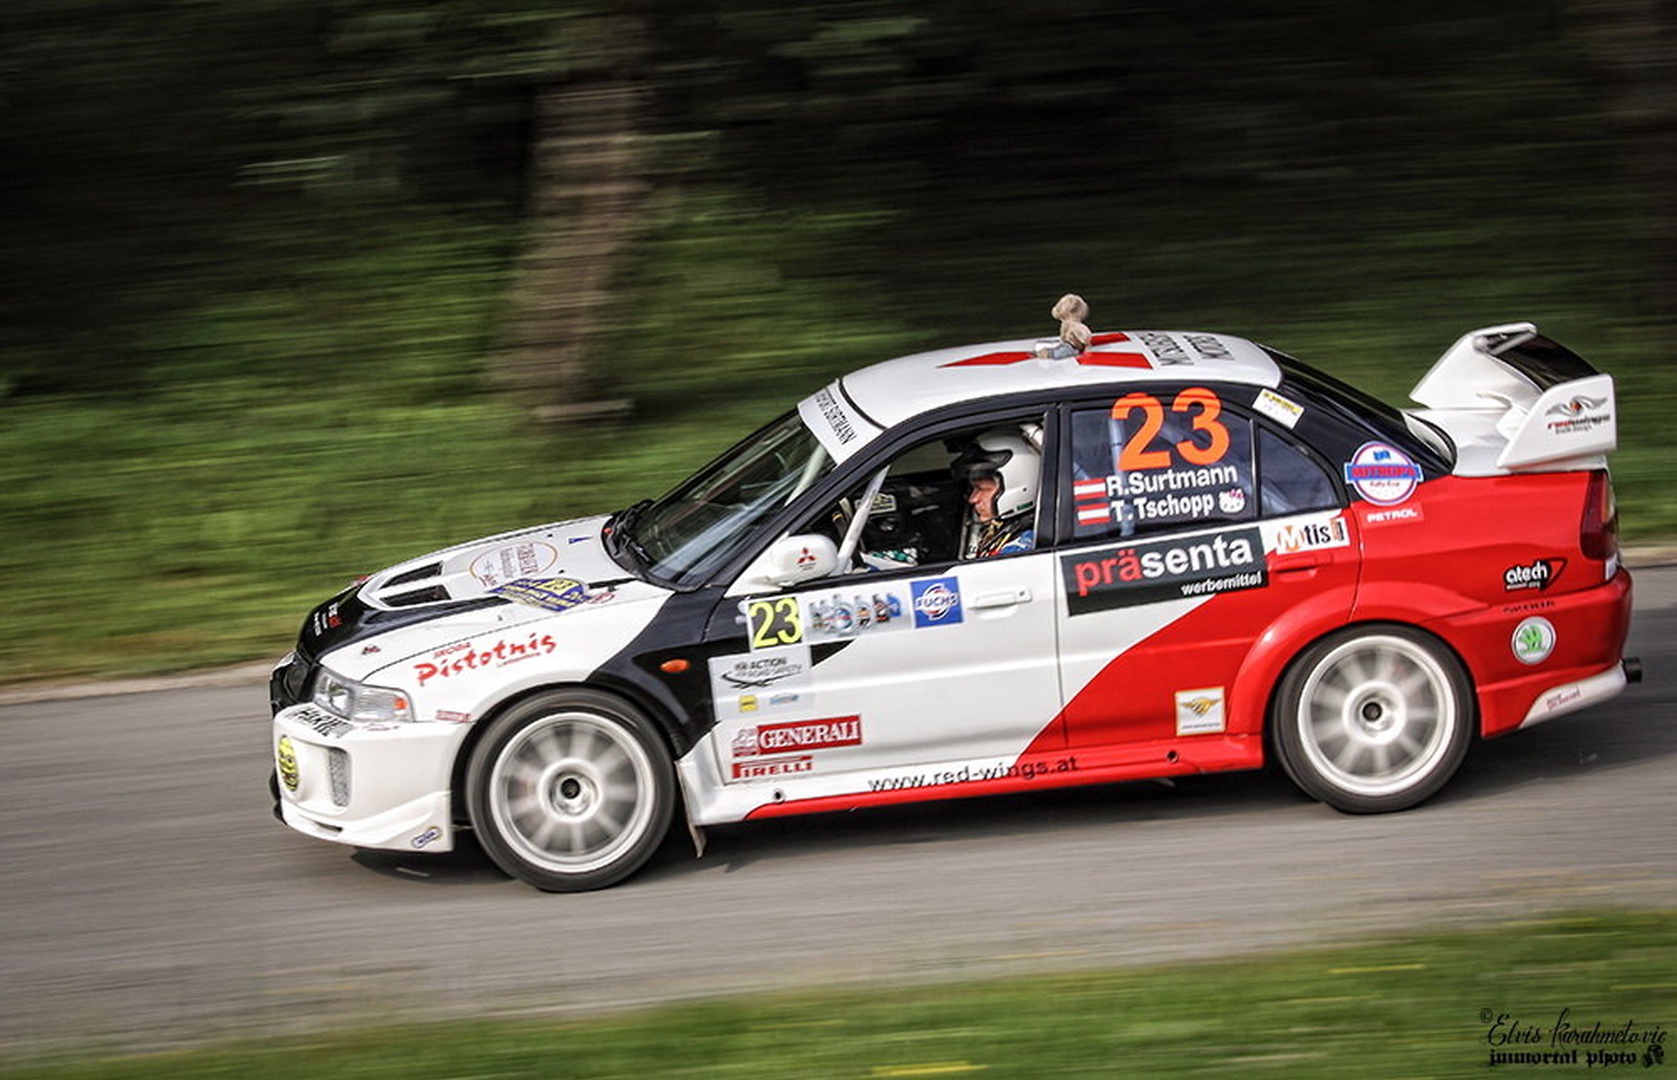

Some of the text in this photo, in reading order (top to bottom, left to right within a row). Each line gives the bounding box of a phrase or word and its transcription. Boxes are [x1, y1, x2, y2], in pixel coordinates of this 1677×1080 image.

[1111, 387, 1231, 471] 23
[1106, 464, 1239, 498] R.Surtmann
[1110, 493, 1215, 522] T. Tschopp
[1366, 508, 1419, 523] PETROL
[1074, 534, 1254, 597] präsenta
[1506, 560, 1548, 584] atech
[1181, 571, 1263, 596] werbemittel
[915, 592, 960, 609] FUCHS
[750, 597, 803, 648] 23
[414, 632, 557, 687] Pistotnis
[759, 720, 860, 750] GENERALI
[732, 755, 814, 779] PIRELLI
[867, 756, 1079, 793] www.red-wings.at
